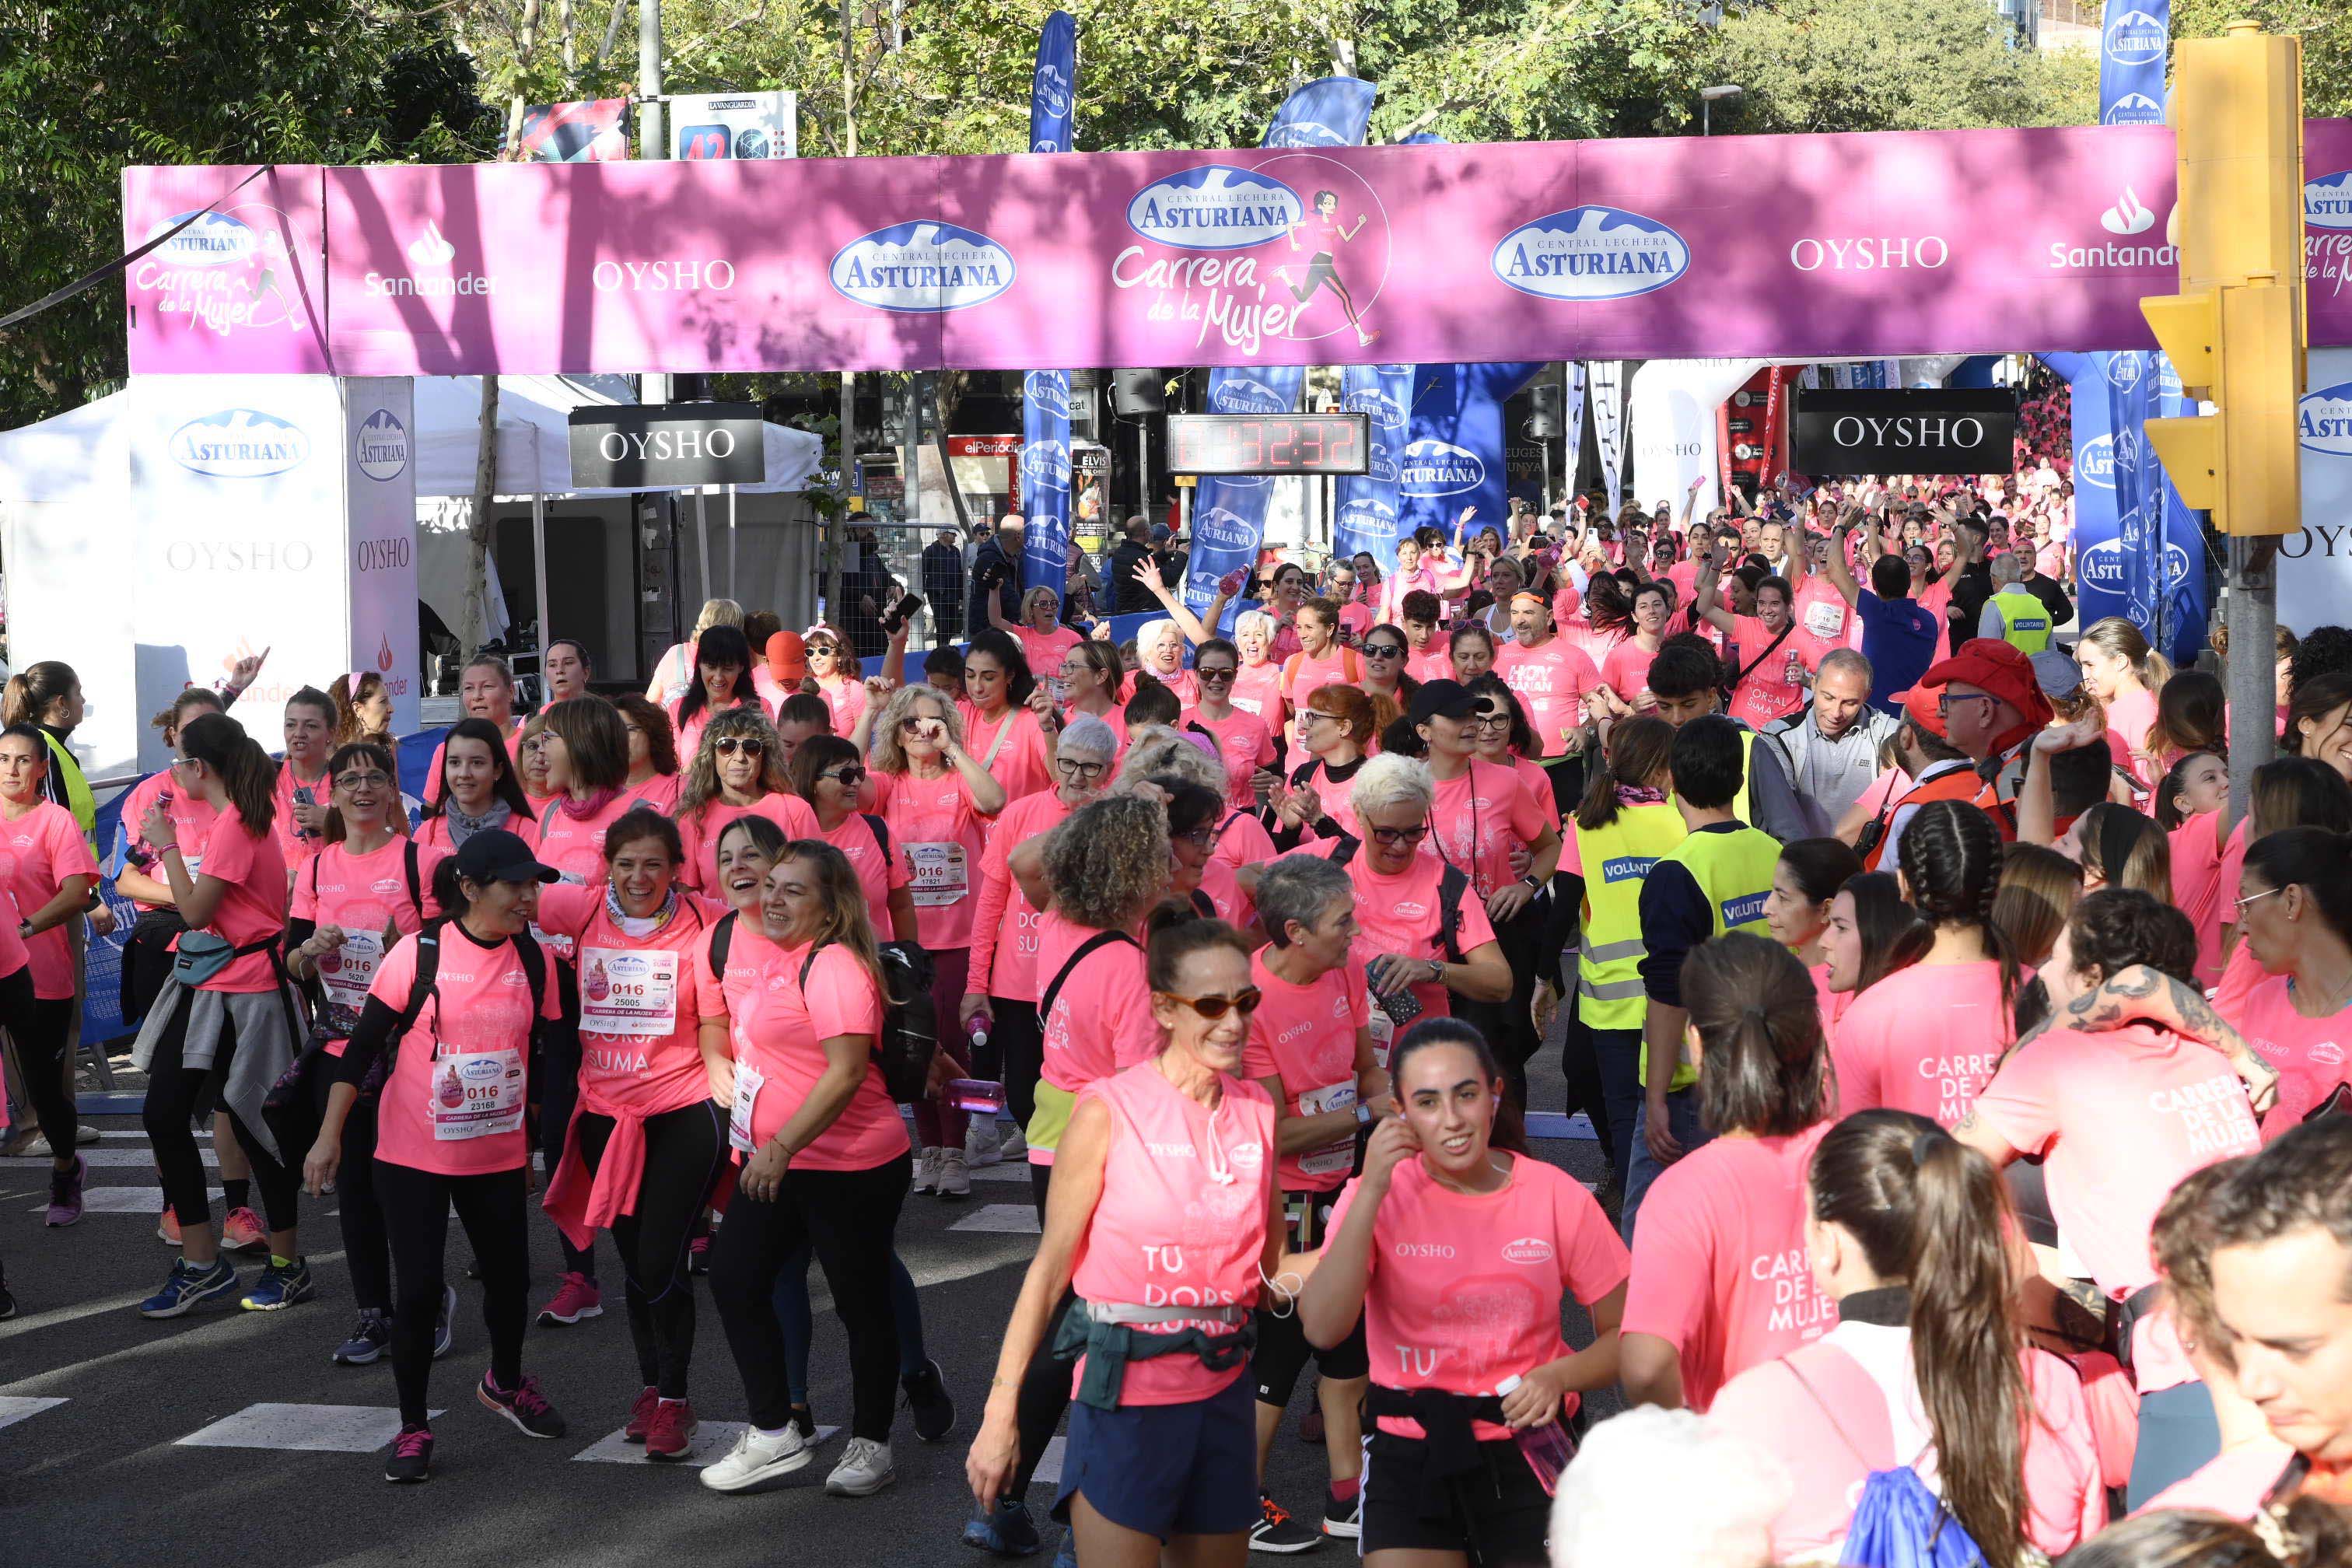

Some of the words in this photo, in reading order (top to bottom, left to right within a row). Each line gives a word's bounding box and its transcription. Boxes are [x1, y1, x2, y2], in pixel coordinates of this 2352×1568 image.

[2112, 32, 2161, 52] ASTURIANA
[1167, 194, 1223, 203] CENTRAL
[1229, 193, 1285, 202] LECHERA
[1140, 198, 1289, 228] ASTURIANA
[1538, 239, 1599, 248] CENTRAL
[1605, 237, 1668, 247] LECHERA
[872, 252, 930, 261] CENTRAL
[936, 250, 996, 261] LECHERA
[1507, 242, 1674, 276] ASTURIANA
[1790, 236, 1948, 271] OYSHO
[2049, 242, 2179, 268] Santand
[844, 255, 1002, 288] ASTURIANA
[1112, 246, 1258, 289] Carrera
[135, 262, 231, 291] Carrera
[364, 271, 498, 297] Santander
[593, 260, 736, 292] OYSHO
[1147, 292, 1174, 322] de
[1181, 291, 1200, 321] la
[1196, 283, 1312, 356] Mujer
[1833, 416, 1983, 449] OYSHO
[181, 434, 301, 461] ASTURIANA
[359, 438, 405, 464] ASTURIANA
[599, 428, 736, 462] OYSHO
[1082, 456, 1107, 466] ELVIS
[358, 537, 409, 572] OYSHO
[1090, 556, 1101, 565] 30
[1508, 665, 1554, 681] HOY
[1507, 681, 1552, 692] GANAN
[919, 866, 943, 877] 016
[1018, 936, 1038, 952] SU
[344, 958, 371, 971] 016
[611, 962, 647, 972] ASTURIANA
[348, 971, 363, 982] 5620
[611, 982, 645, 995] 016
[614, 998, 640, 1007] 25005
[590, 1019, 616, 1027] OYSHO
[587, 1049, 648, 1071] SUMA
[465, 1066, 500, 1076] ASTURIANA
[467, 1085, 499, 1099] 016
[1941, 1076, 1971, 1097] DE
[471, 1101, 495, 1111] 23168
[443, 1125, 473, 1135] OYSHO
[1306, 1159, 1332, 1169] OYSHO
[1395, 1242, 1456, 1258] OYSHO
[1506, 1244, 1551, 1258] ASTURIANA
[1142, 1245, 1183, 1273] TU
[1774, 1278, 1806, 1304] DE
[1395, 1344, 1437, 1377] TU
